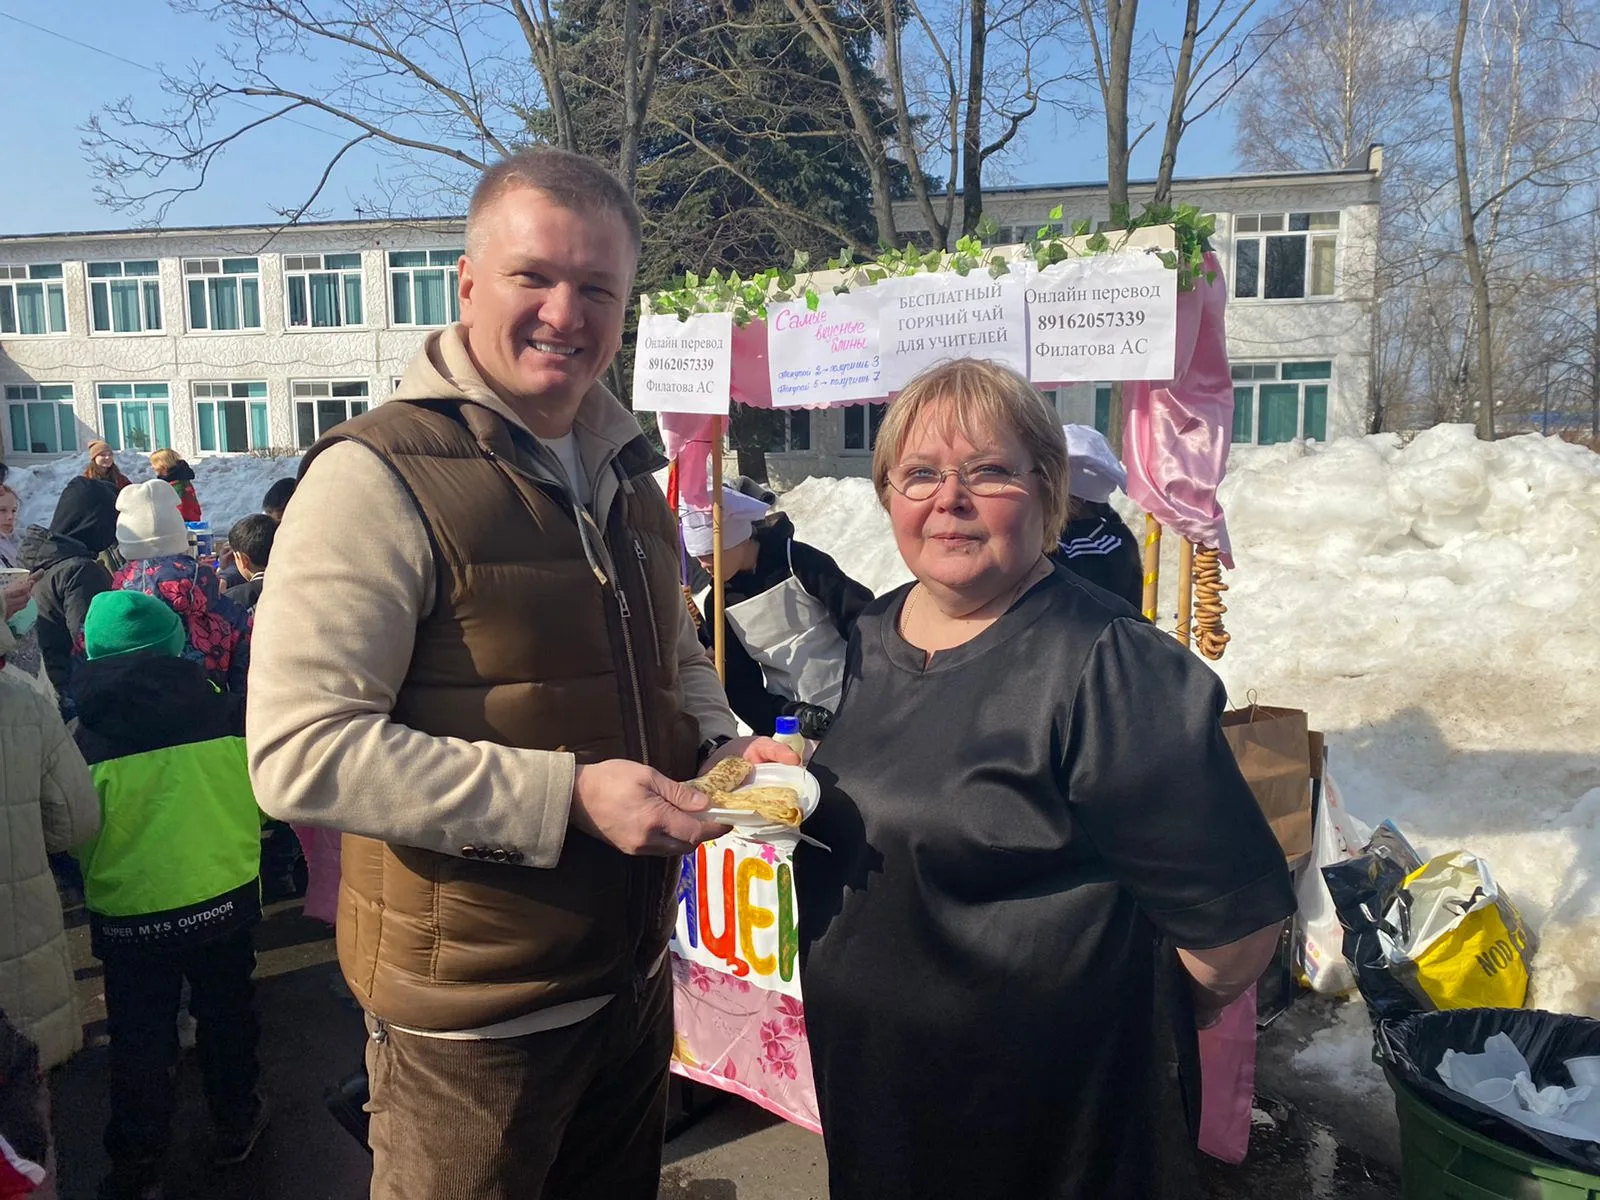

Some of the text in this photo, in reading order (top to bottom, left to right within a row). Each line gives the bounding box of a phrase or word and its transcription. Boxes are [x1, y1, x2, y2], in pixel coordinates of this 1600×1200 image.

[899, 282, 1002, 309] БЕСПЛАТНЫЙ
[1024, 285, 1161, 304] Онлайн перевод
[775, 308, 827, 331] Самые
[898, 304, 1004, 331] ГОРЯЧИЙ ЧАЙ
[1038, 310, 1146, 330] 89162057339
[645, 336, 723, 352] Онлайн перевод
[896, 326, 1008, 355] ДЛЯ УЧИТЕЛЕЙ
[1035, 338, 1149, 357] Филатова АС
[648, 358, 714, 371] 89162057339
[815, 365, 822, 376] 2
[872, 355, 880, 368] 3
[646, 379, 715, 393] Филатова АС
[813, 379, 820, 388] 5
[872, 371, 880, 381] 7
[102, 926, 133, 937] SUPER
[178, 901, 234, 928] OUTDOOR
